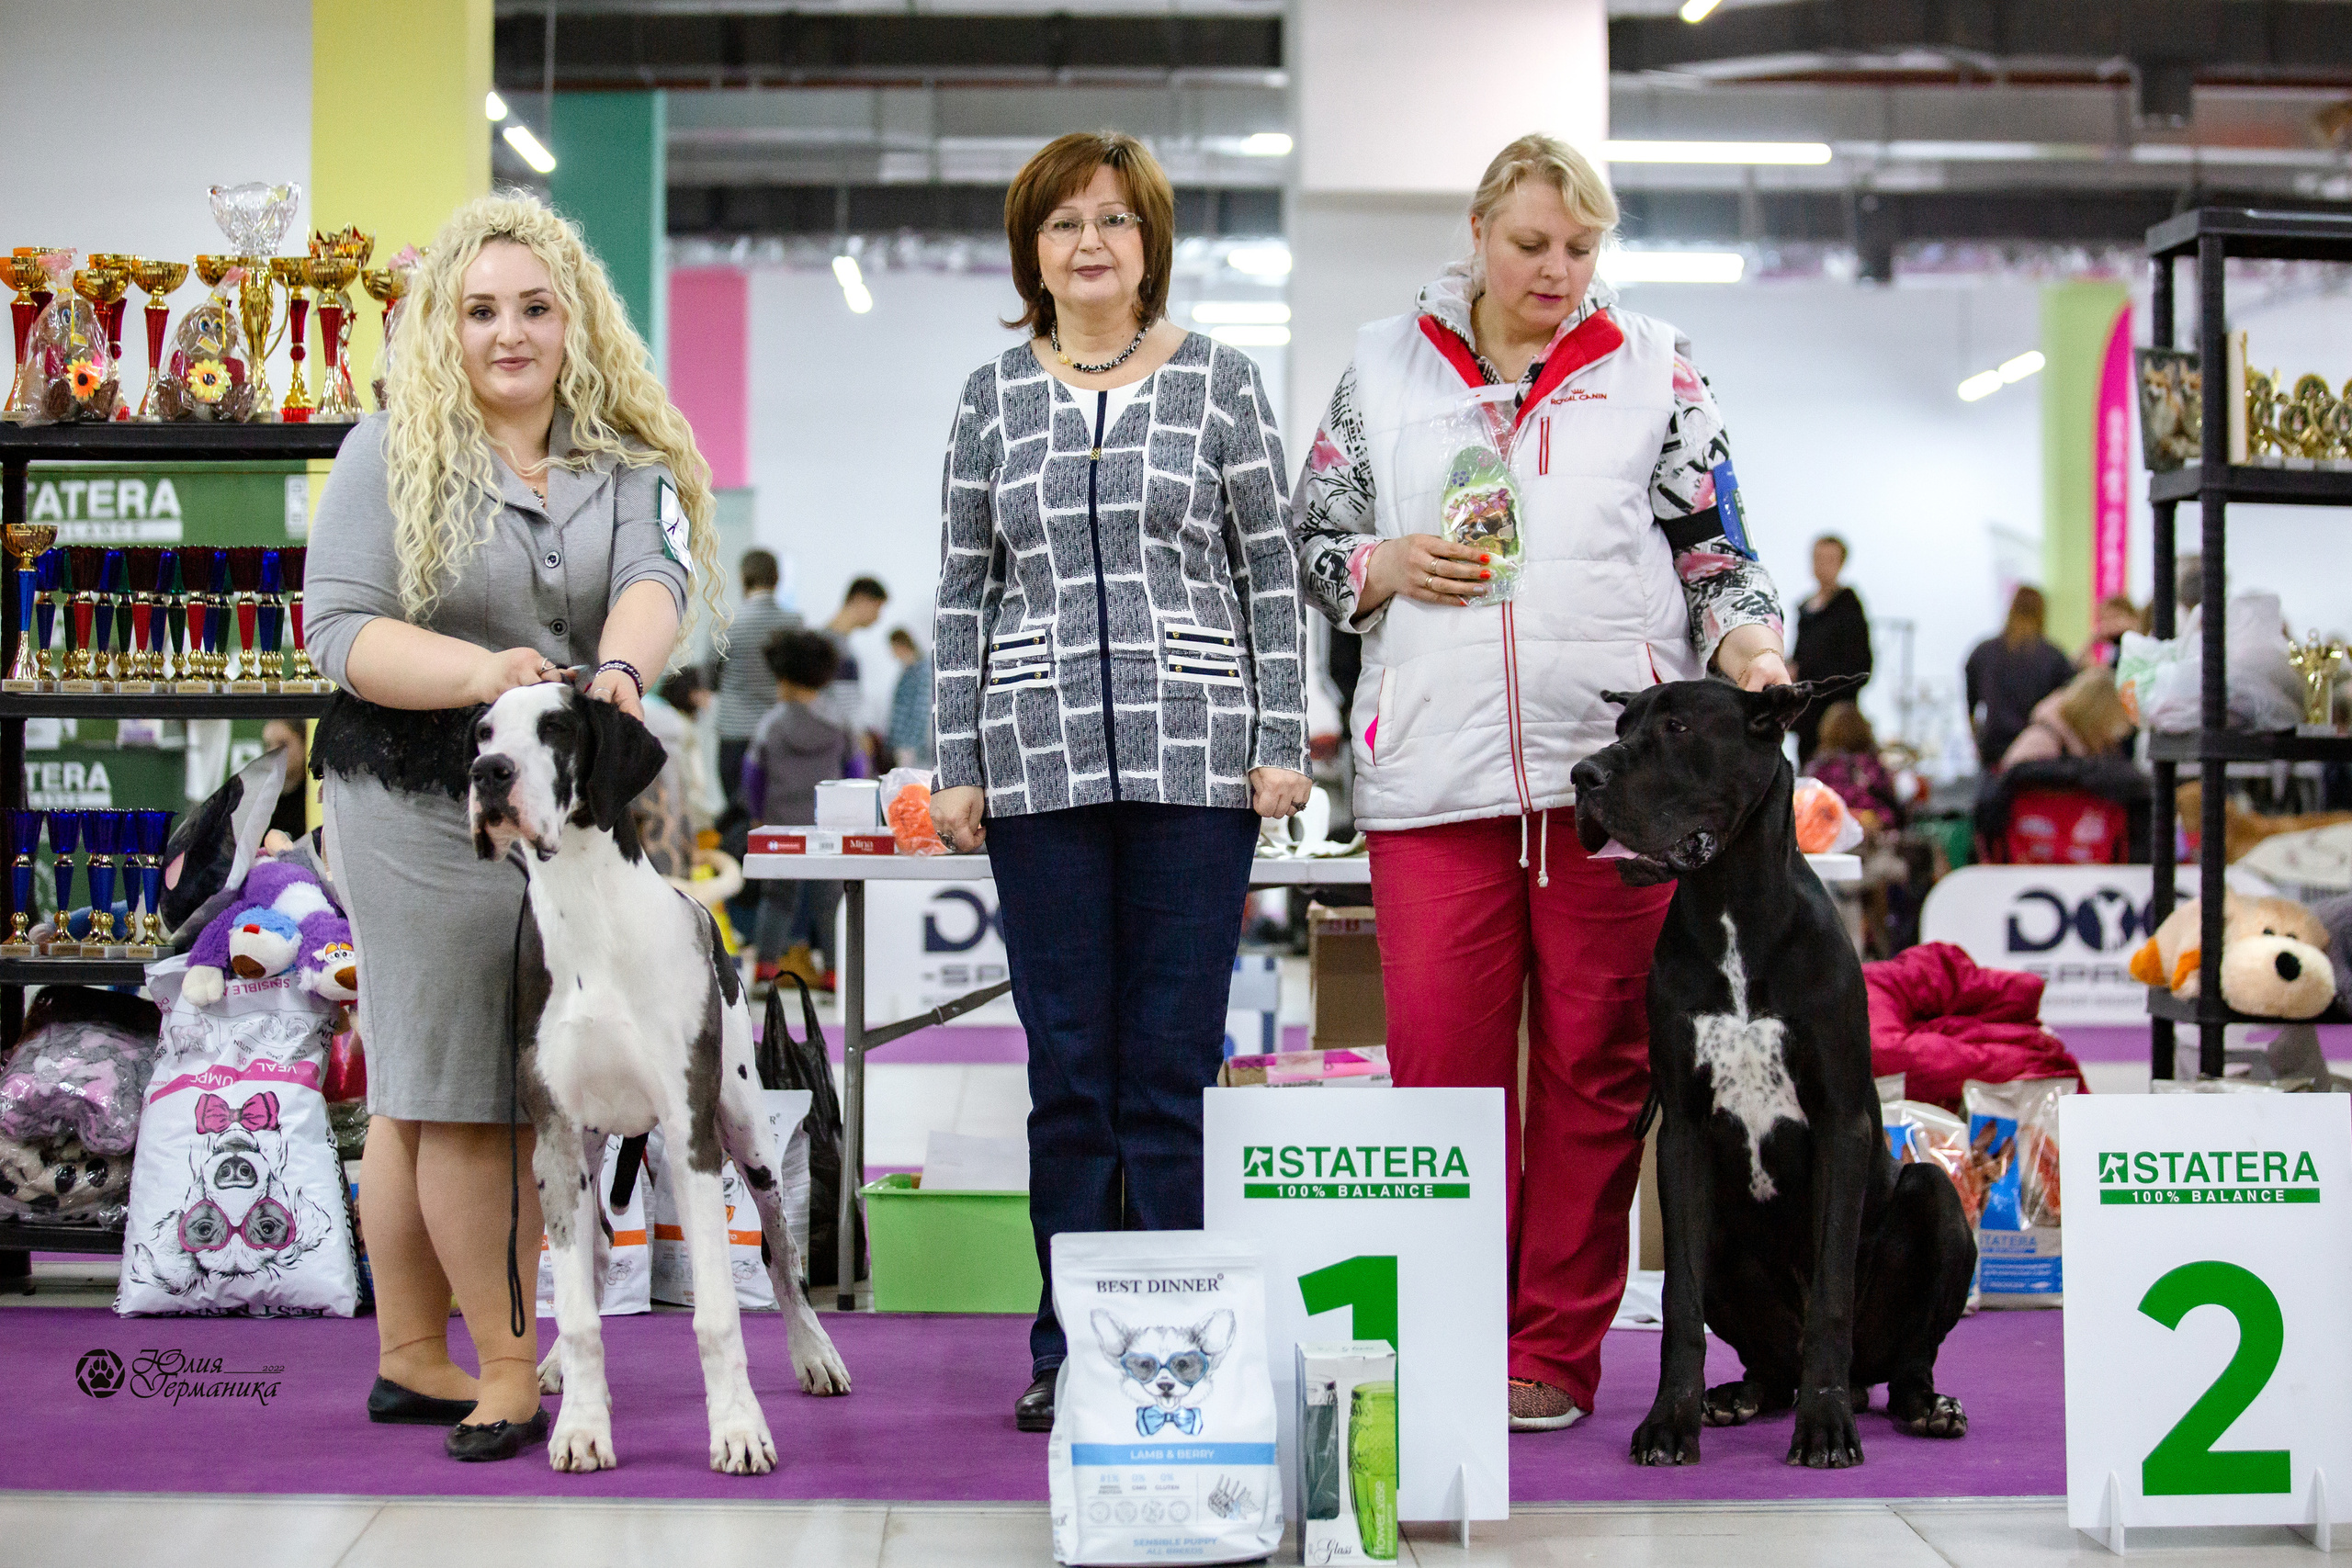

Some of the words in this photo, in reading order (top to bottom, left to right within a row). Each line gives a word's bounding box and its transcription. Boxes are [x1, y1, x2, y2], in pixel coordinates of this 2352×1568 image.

[1551, 395, 1577, 404] ROYAL
[255, 1062, 298, 1075] VEAL
[1279, 1145, 1470, 1179] STATERA
[2133, 1151, 2320, 1184] STATERA
[1277, 1185, 1326, 1198] 100%
[1338, 1184, 1434, 1198] BALANCE
[2132, 1190, 2180, 1203] 100%
[2191, 1190, 2286, 1202] BALANCE
[1096, 1280, 1142, 1293] BEST
[1297, 1255, 1400, 1490] 1
[2137, 1259, 2291, 1496] 2
[1130, 1450, 1163, 1460] LAMB
[1166, 1450, 1174, 1460] &
[1177, 1449, 1215, 1459] BERRY
